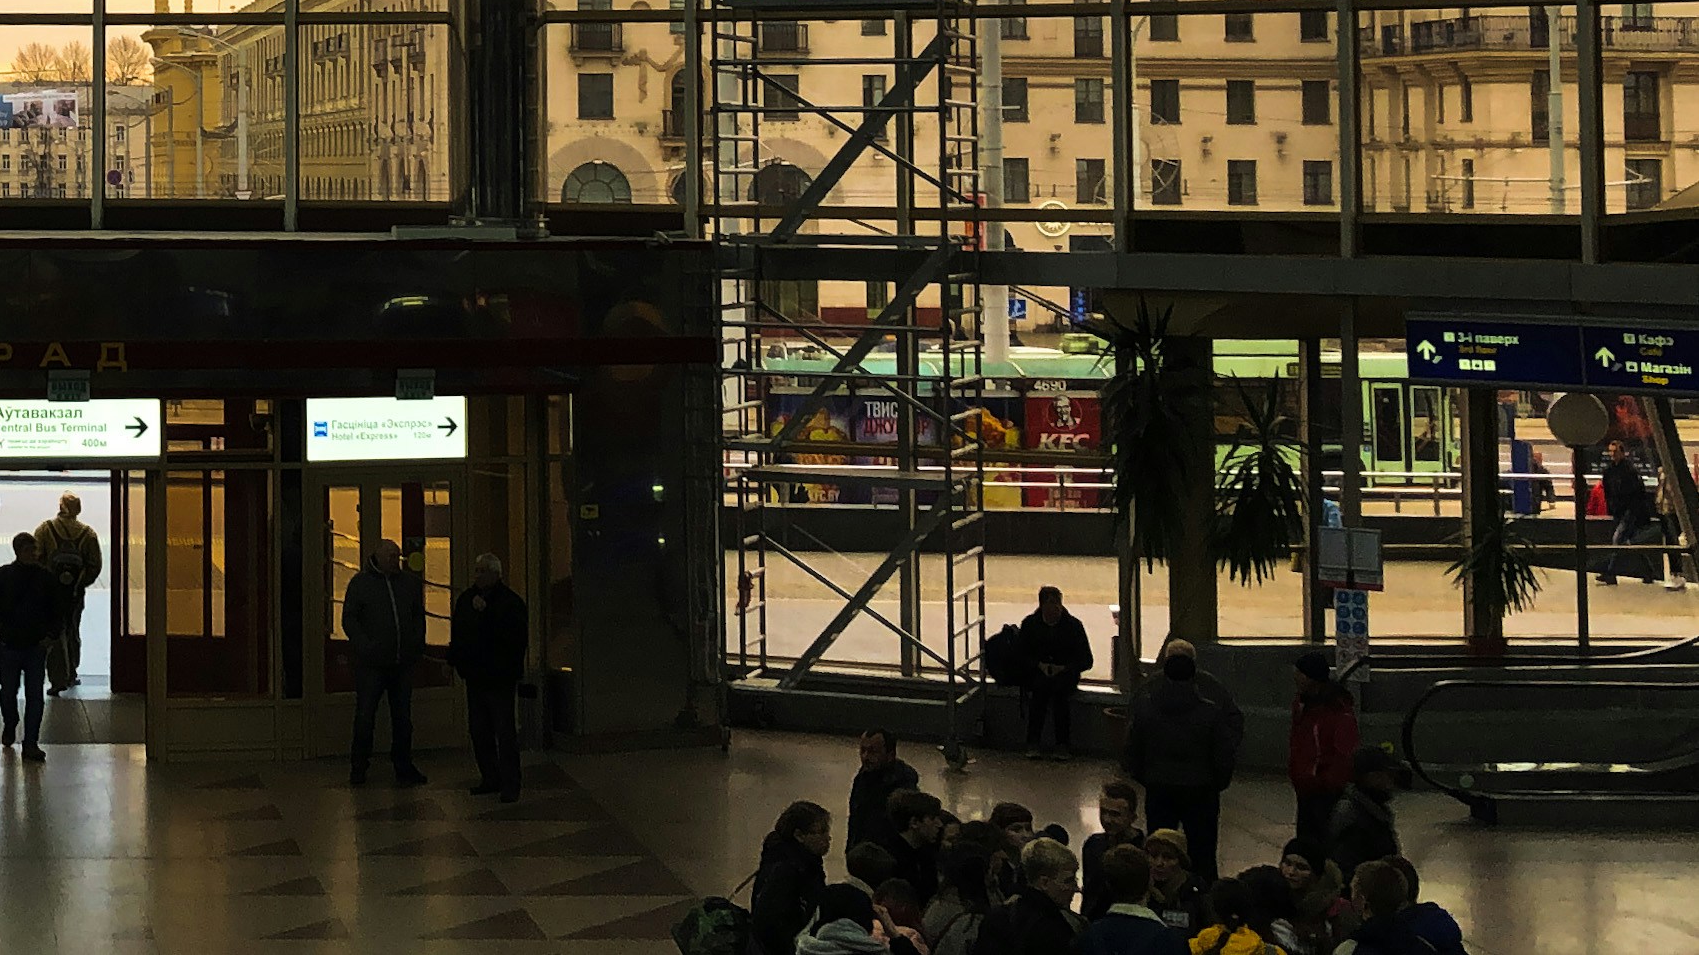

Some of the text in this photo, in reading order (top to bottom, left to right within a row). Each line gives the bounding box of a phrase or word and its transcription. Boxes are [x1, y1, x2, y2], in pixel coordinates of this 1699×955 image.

[1474, 333, 1520, 348] паверх
[1638, 334, 1675, 347] Кафэ
[1640, 361, 1693, 375] Магазін
[1033, 379, 1067, 392] 4690
[1640, 374, 1670, 386] Shop
[35, 423, 57, 433] Bus
[61, 423, 107, 433] Terminal
[331, 419, 433, 432] Гасцініца «Экспрэс»
[81, 438, 107, 448] 400м
[331, 432, 398, 442] Hotel «Express»
[1038, 433, 1090, 450] KFC
